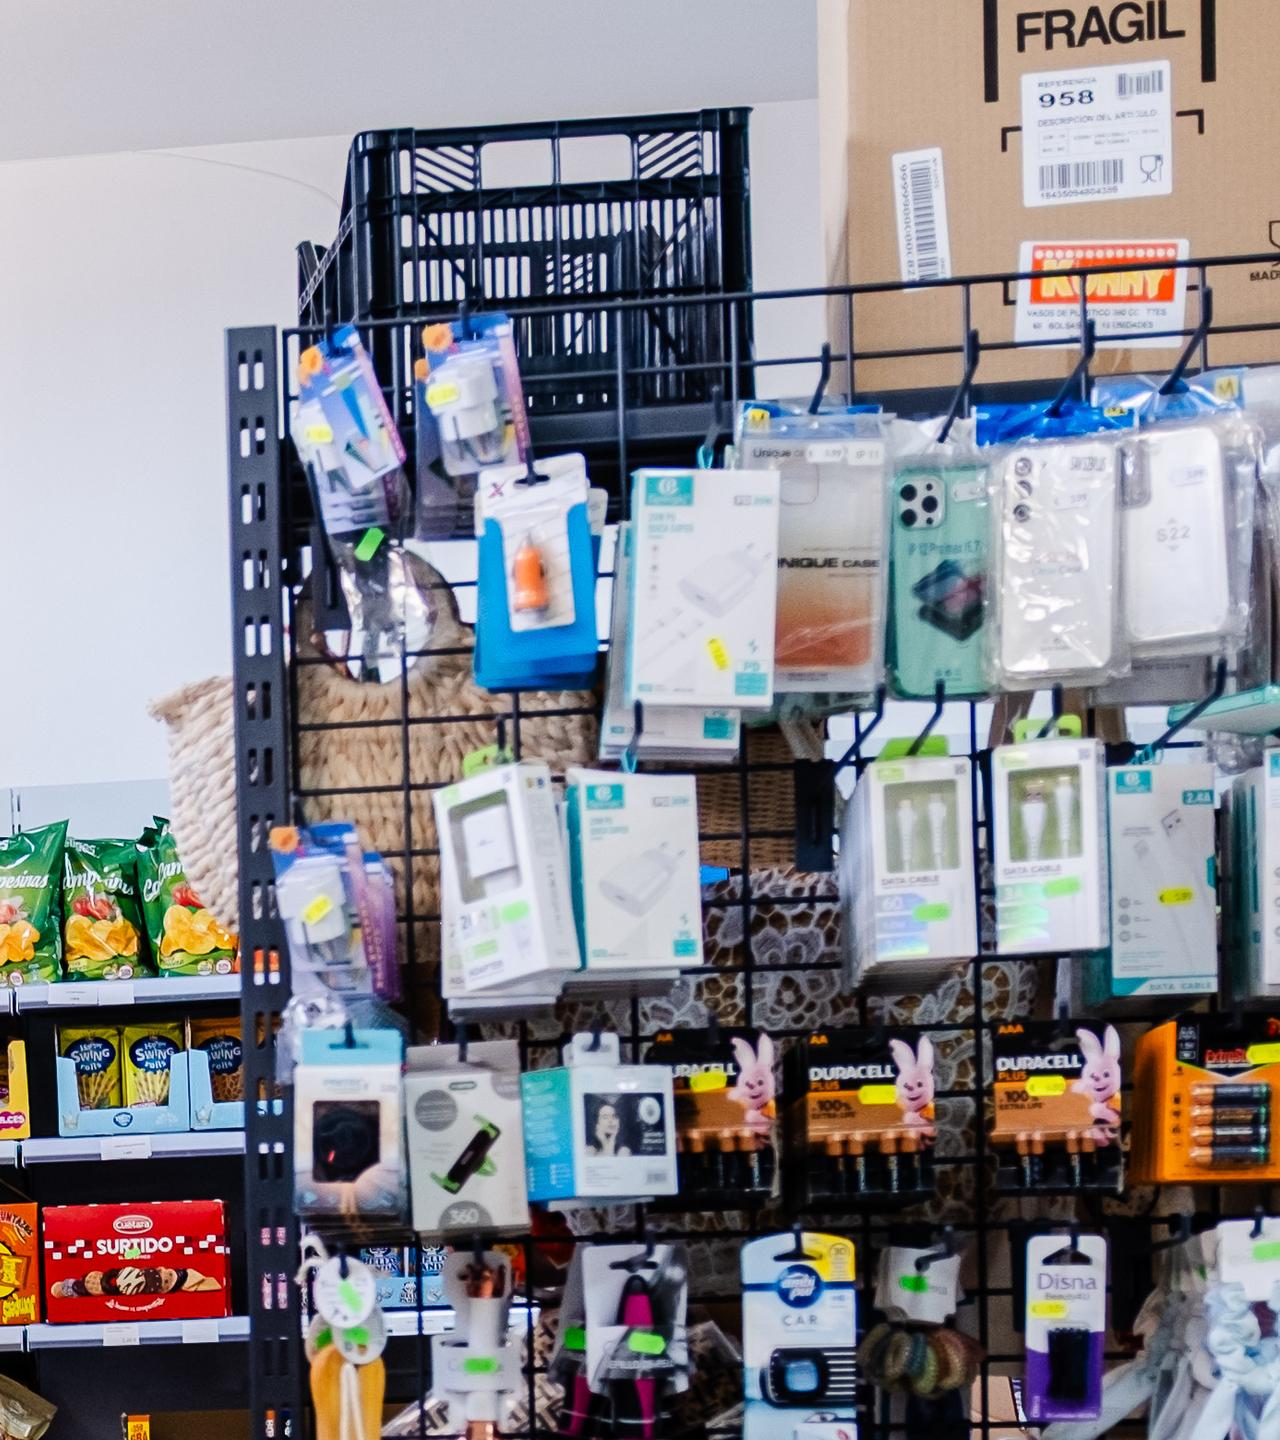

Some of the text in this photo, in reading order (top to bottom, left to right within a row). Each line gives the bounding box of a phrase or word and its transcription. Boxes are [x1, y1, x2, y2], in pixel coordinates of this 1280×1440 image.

[1038, 89, 1095, 109] 958
[1156, 526, 1191, 543] S22
[655, 1032, 674, 1043] AA
[997, 1024, 1024, 1035] AAA
[808, 1034, 829, 1046] AA
[70, 1047, 111, 1063] SWING
[134, 1046, 175, 1062] SWING
[996, 1053, 1082, 1071] DURACELL
[80, 1061, 103, 1071] rolls
[143, 1060, 168, 1070] rolls
[808, 1063, 895, 1081] DURACELL
[998, 1071, 1028, 1082] PLUS
[811, 1080, 841, 1091] PLUS
[449, 1208, 479, 1226] 360
[96, 1236, 174, 1257] SURTIDO
[1037, 1273, 1098, 1291] Disna
